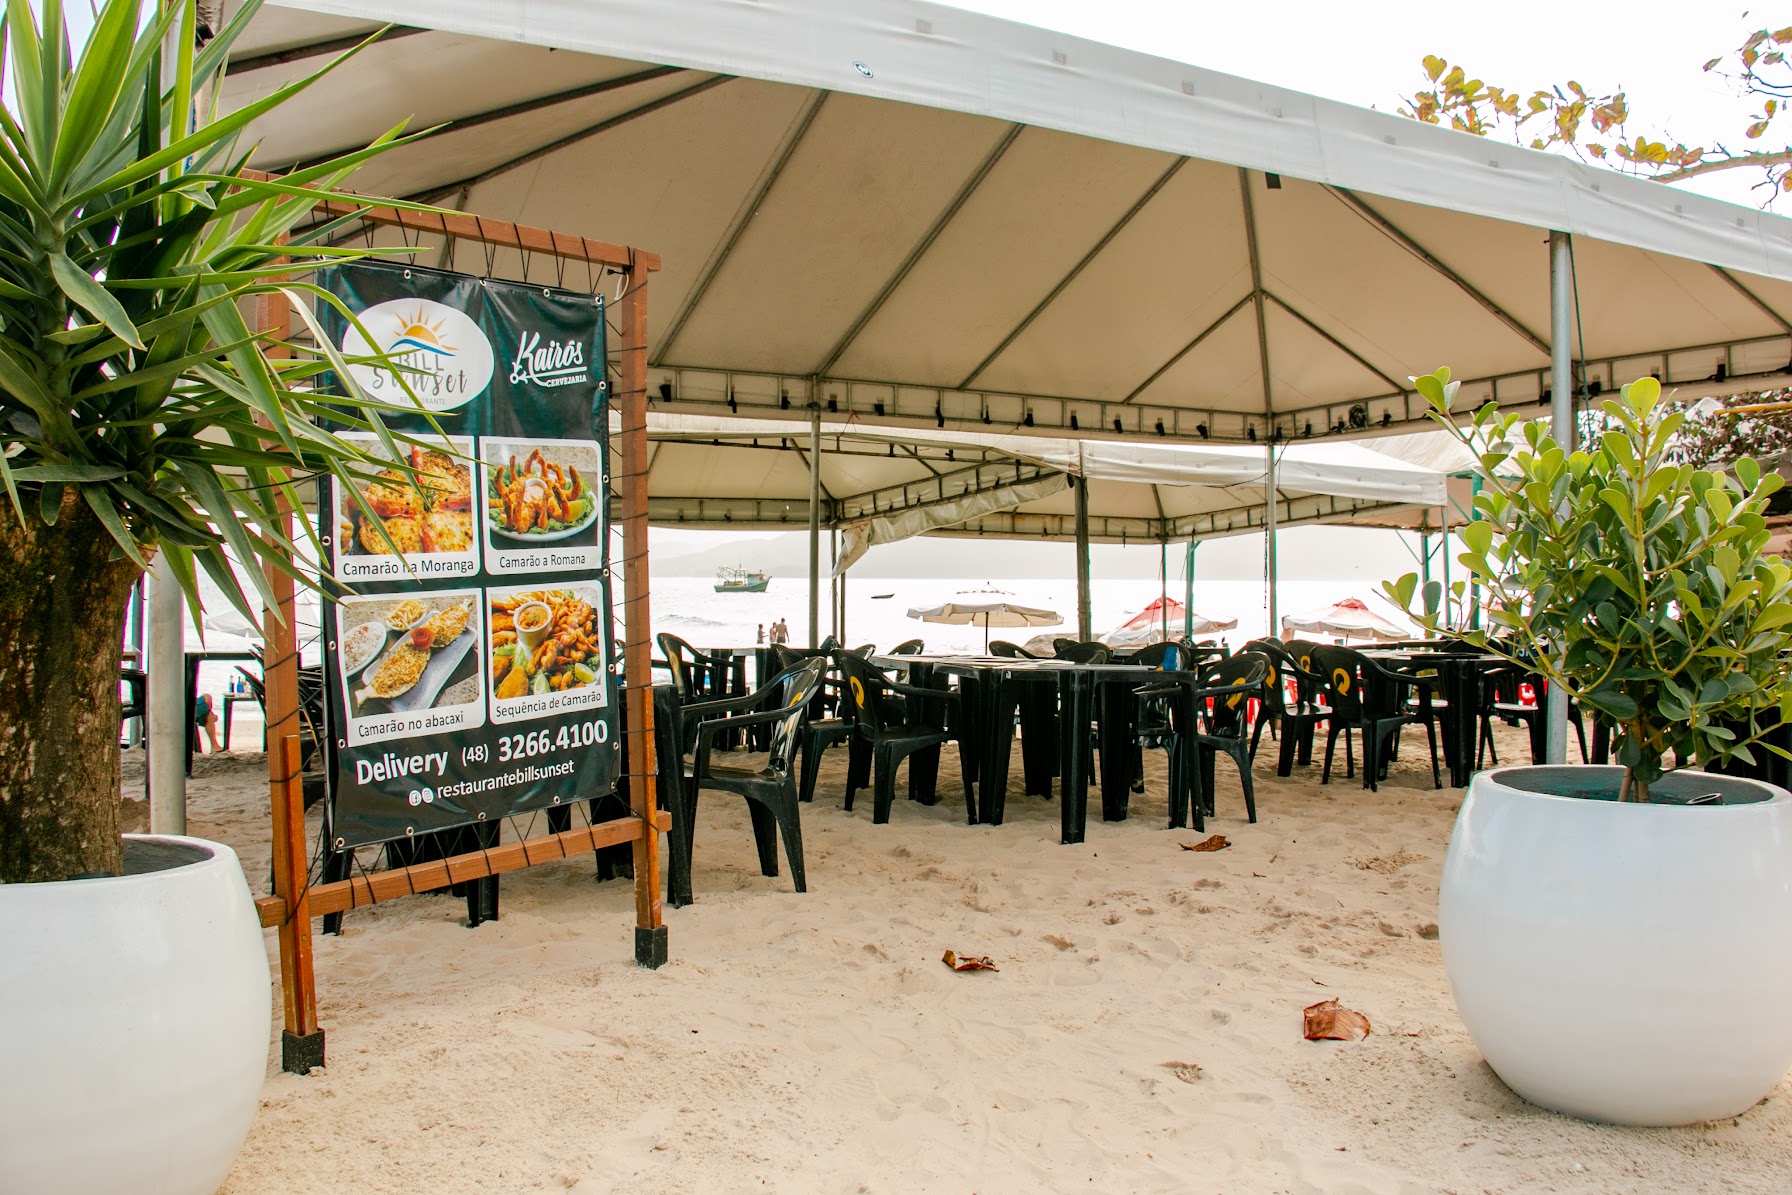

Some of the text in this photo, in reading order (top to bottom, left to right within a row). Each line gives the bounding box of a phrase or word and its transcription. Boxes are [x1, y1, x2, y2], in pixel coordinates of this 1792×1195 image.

[398, 353, 444, 371] BILL
[546, 374, 587, 388] CERVEJARIA
[399, 396, 446, 406] RESURANTE
[343, 561, 399, 576] Camarão
[421, 559, 474, 574] Moranga
[499, 554, 586, 568] Camarão a Romana
[496, 690, 602, 719] Sequência de Camarão
[358, 711, 464, 737] Camarão no abacaxi
[355, 719, 608, 786] Delivery (48) 3266.4100
[436, 759, 575, 799] restaurantebillsunset
